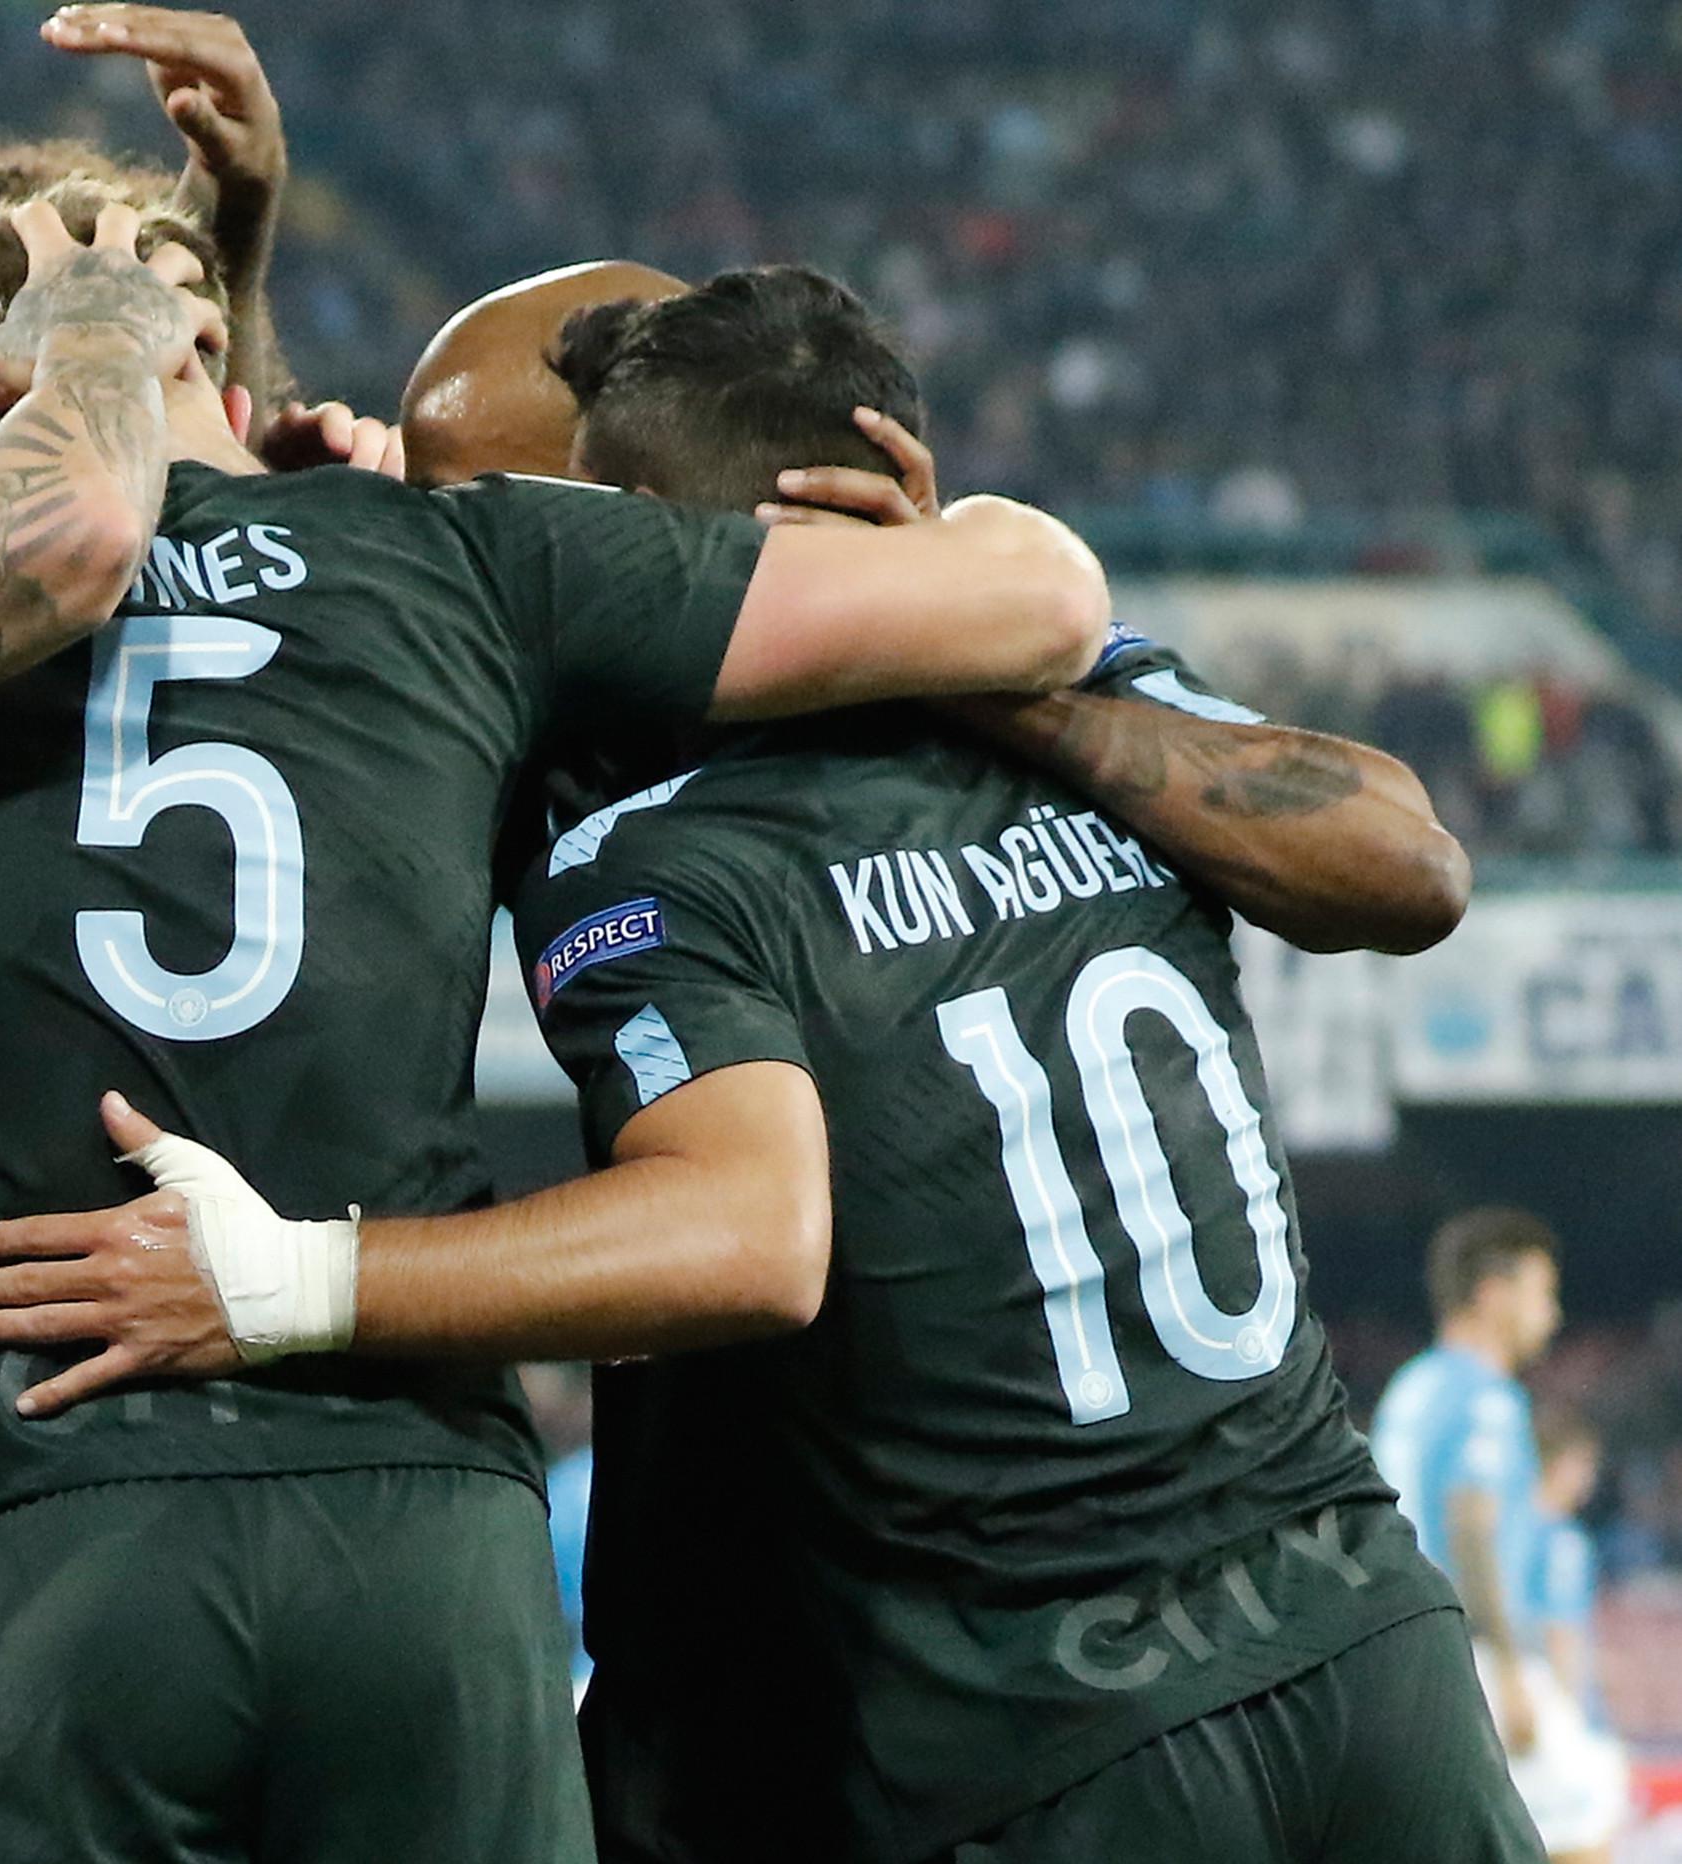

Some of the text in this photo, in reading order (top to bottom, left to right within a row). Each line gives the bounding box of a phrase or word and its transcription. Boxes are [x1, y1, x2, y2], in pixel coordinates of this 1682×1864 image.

[75, 615, 306, 1042] 5
[829, 803, 1178, 954] KUN AGÜER
[549, 909, 660, 979] RESPECT
[935, 946, 1295, 1426] 10
[1056, 1505, 1371, 1690] CITY
